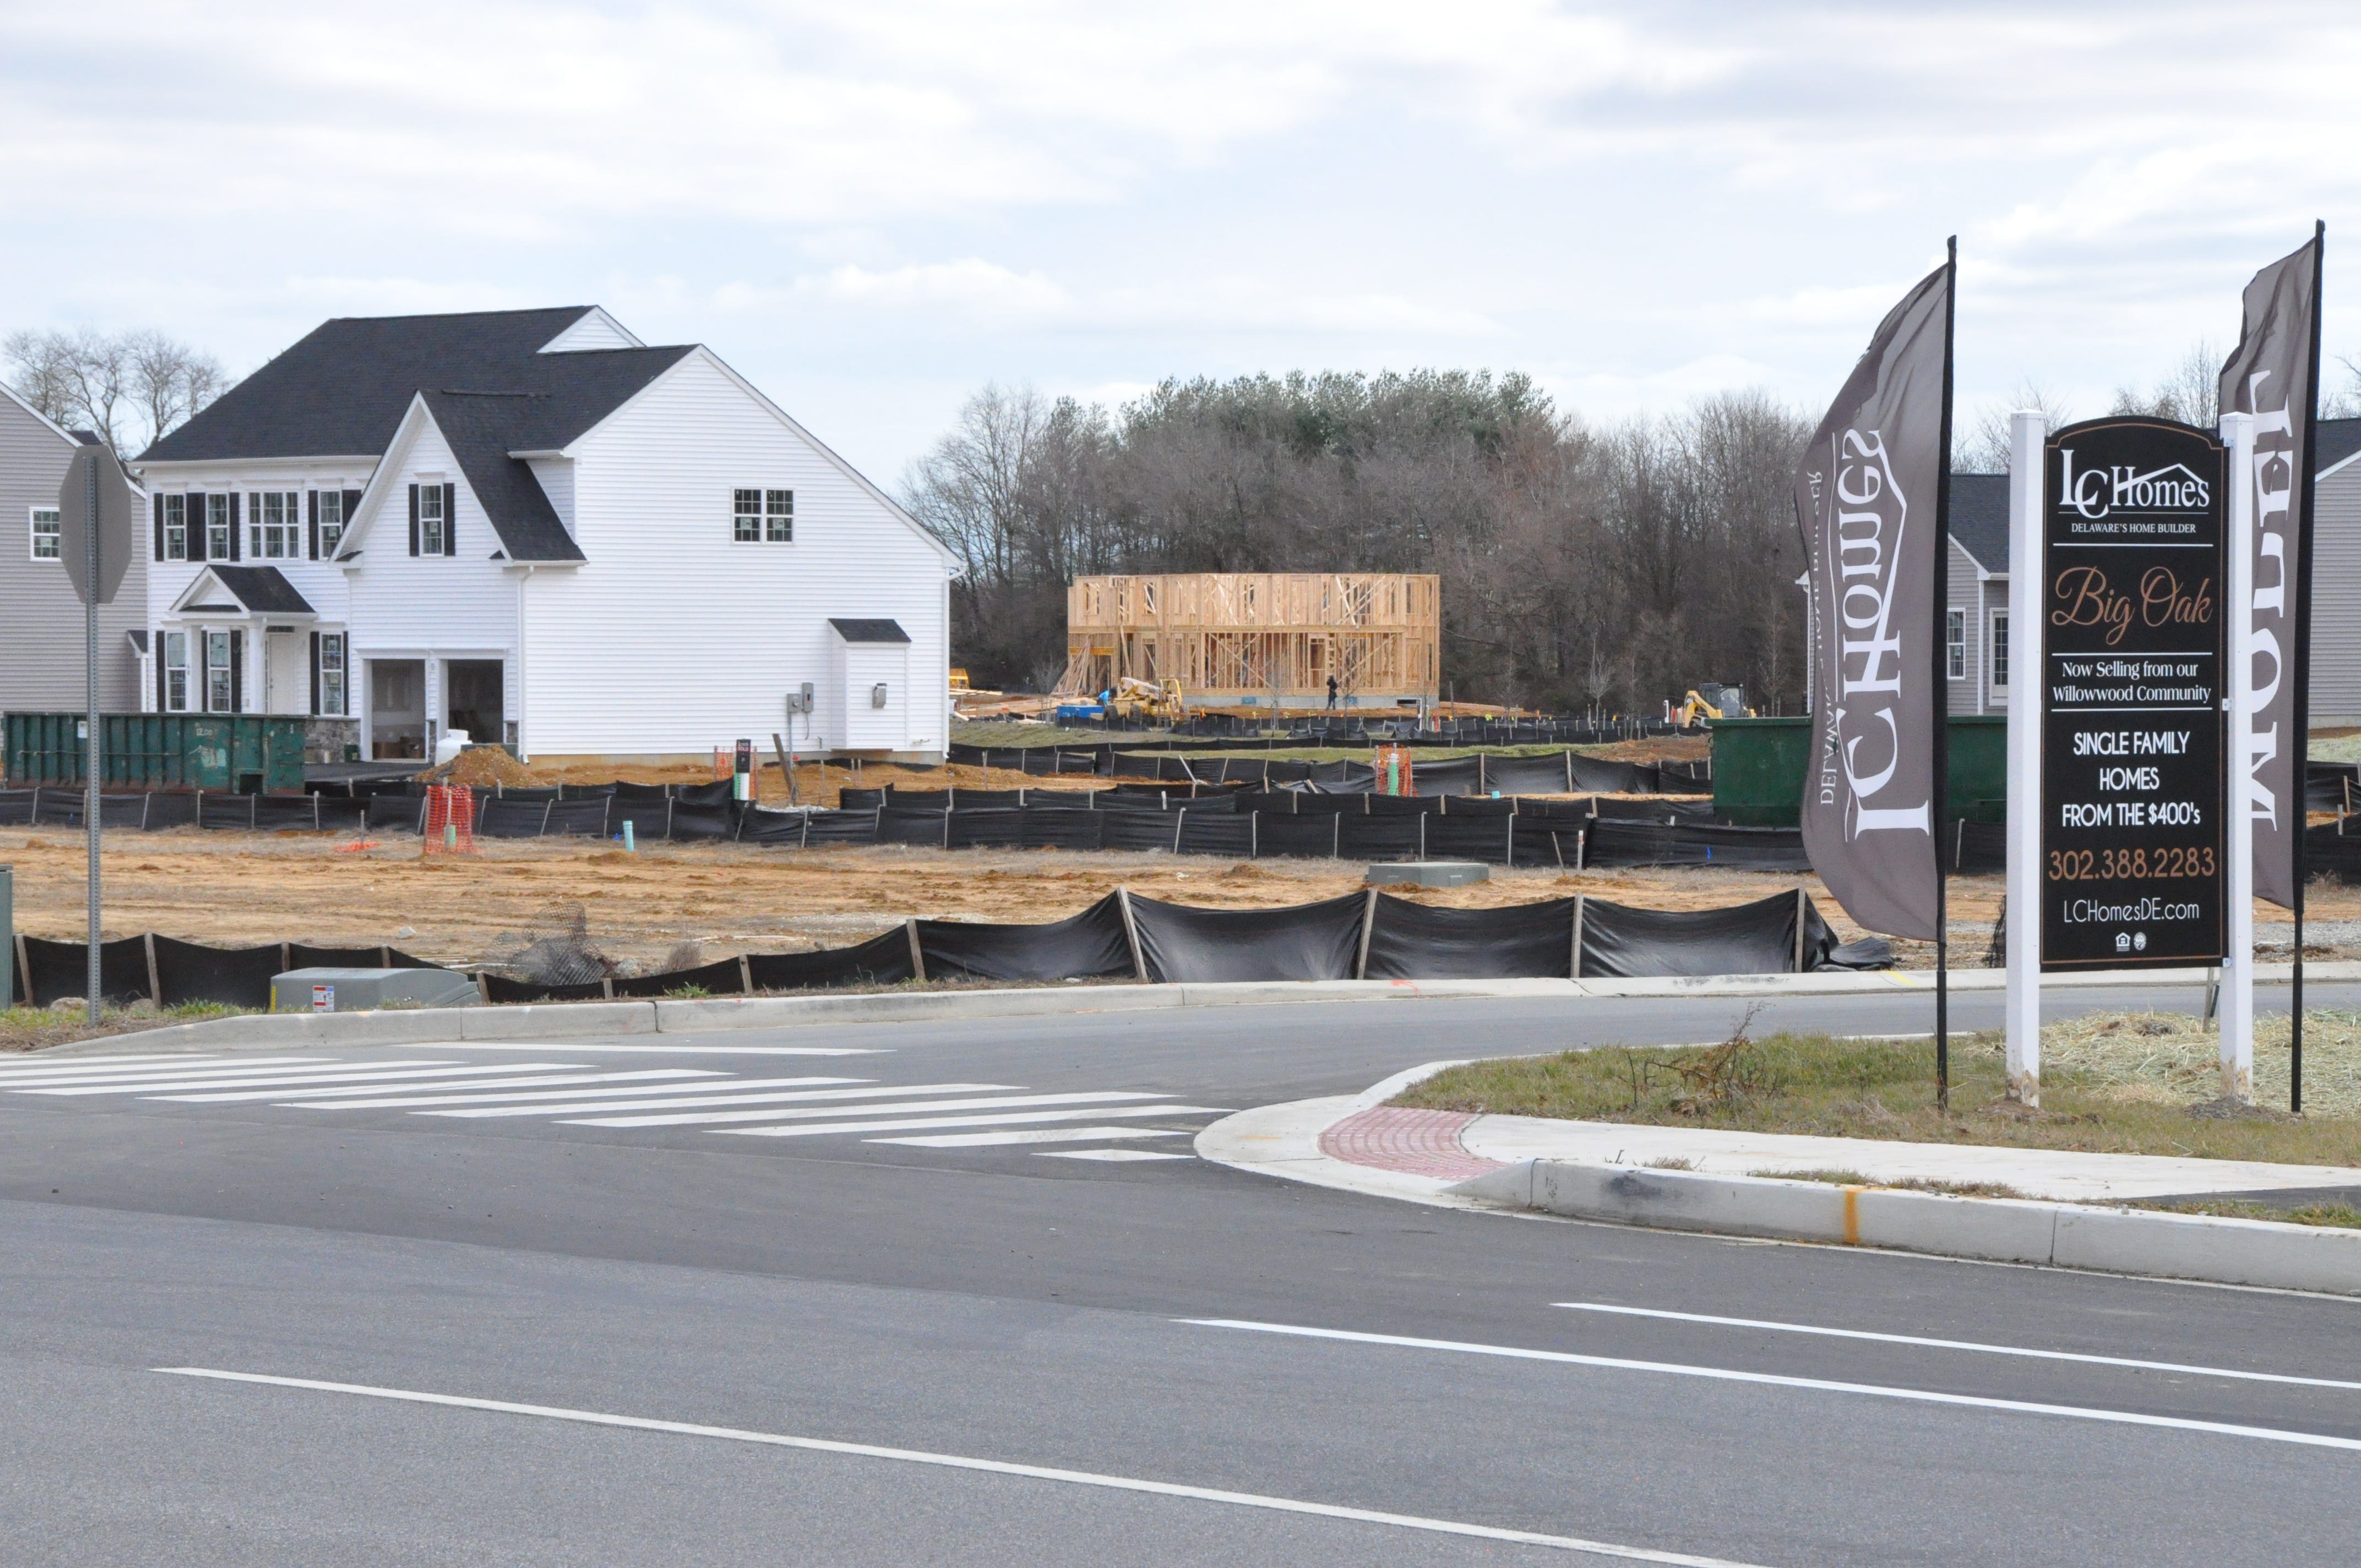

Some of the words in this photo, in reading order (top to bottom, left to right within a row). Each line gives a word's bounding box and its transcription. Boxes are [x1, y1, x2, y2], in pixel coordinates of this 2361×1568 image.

[2072, 523, 2127, 532] DELAWARE'S
[2130, 524, 2156, 532] HOME
[2158, 524, 2196, 533] BUILDER
[2052, 566, 2135, 645] Big
[2141, 567, 2212, 627] Oak
[2063, 662, 2093, 677] Now
[2096, 661, 2140, 680] Selling
[2143, 661, 2173, 677] from
[2177, 665, 2198, 677] our
[2053, 685, 2133, 701] Willowwood
[2137, 685, 2211, 704] Community
[2073, 732, 2129, 755] SINGLE
[2134, 731, 2190, 754] FAMILY
[2100, 767, 2159, 790] HOMES
[2063, 803, 2112, 827] FROM
[2116, 803, 2144, 826] THE
[2148, 802, 2200, 825] $400's
[2049, 847, 2215, 880] 302.388.2283
[2064, 897, 2199, 922] LCHomesDE.com
